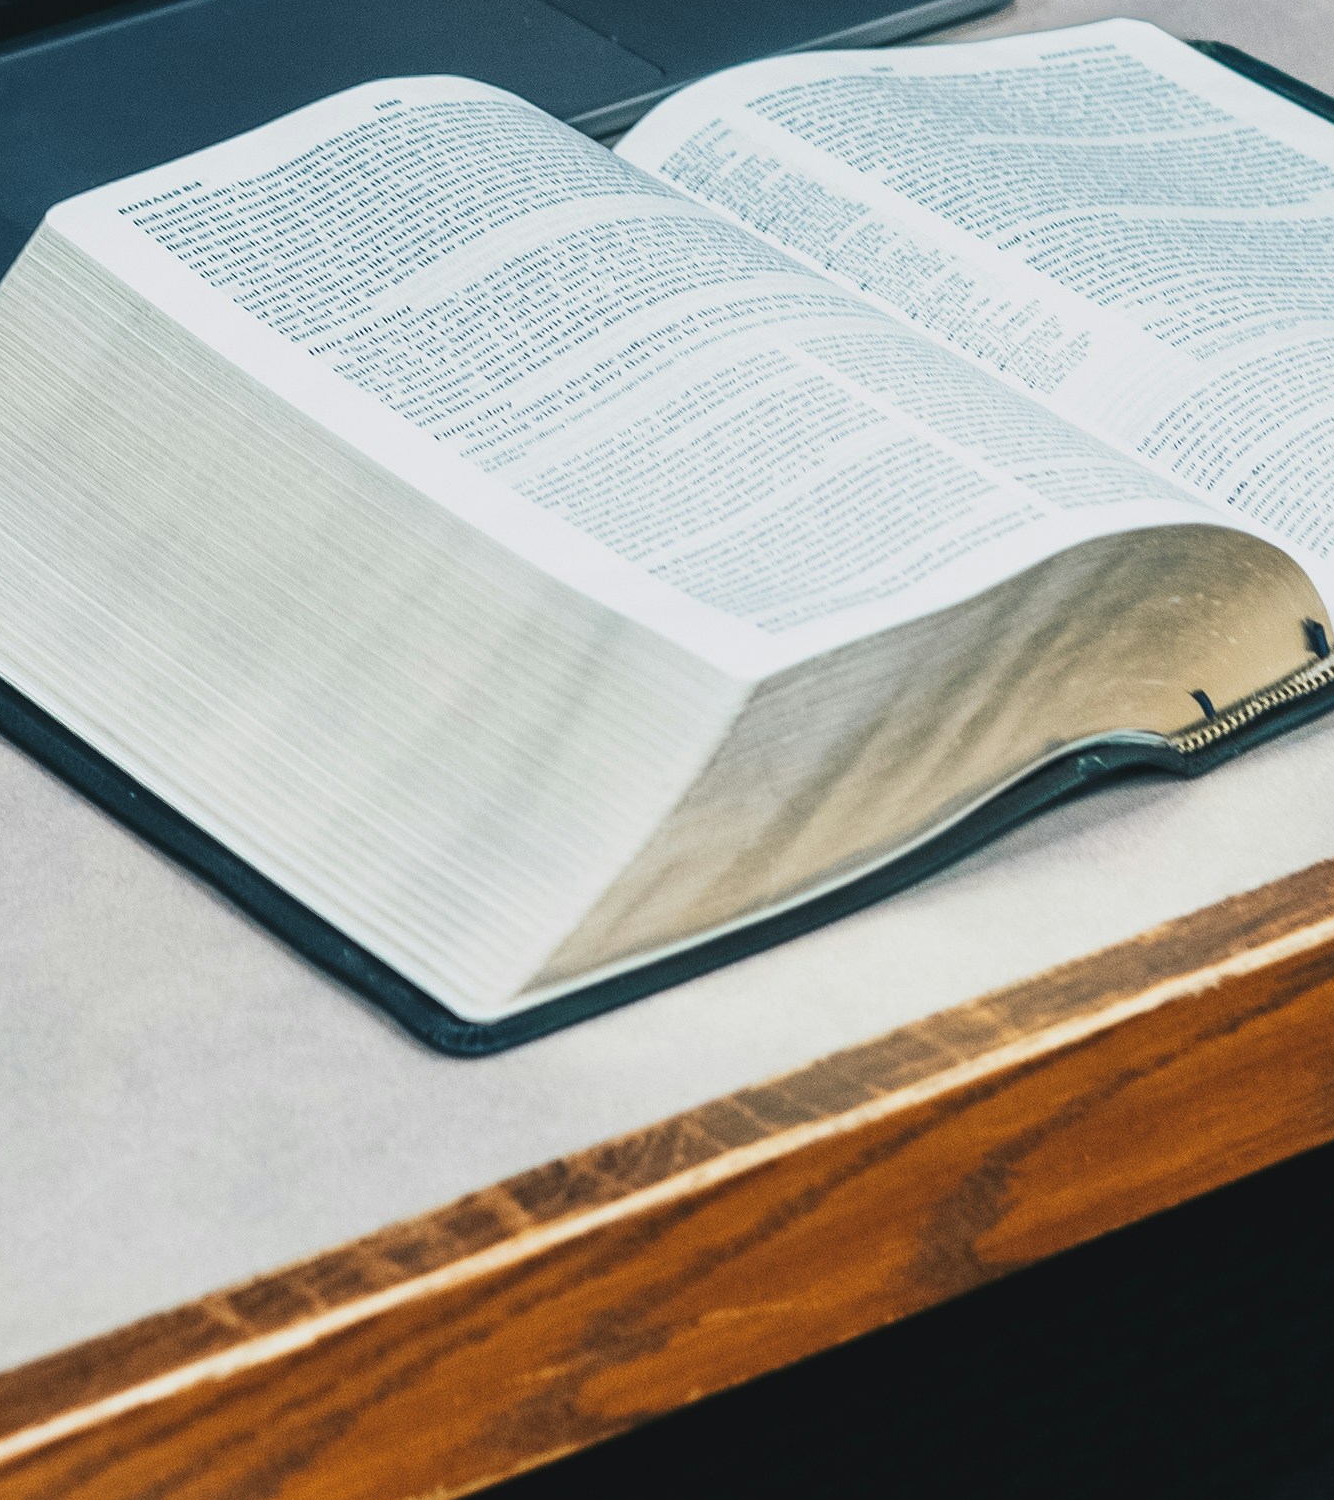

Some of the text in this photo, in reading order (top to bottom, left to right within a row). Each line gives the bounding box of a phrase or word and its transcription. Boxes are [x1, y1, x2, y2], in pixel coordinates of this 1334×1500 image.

[117, 181, 203, 216] ROMANS 8:4
[308, 305, 412, 356] Heirs with Christ
[433, 401, 512, 442] Future Glory
